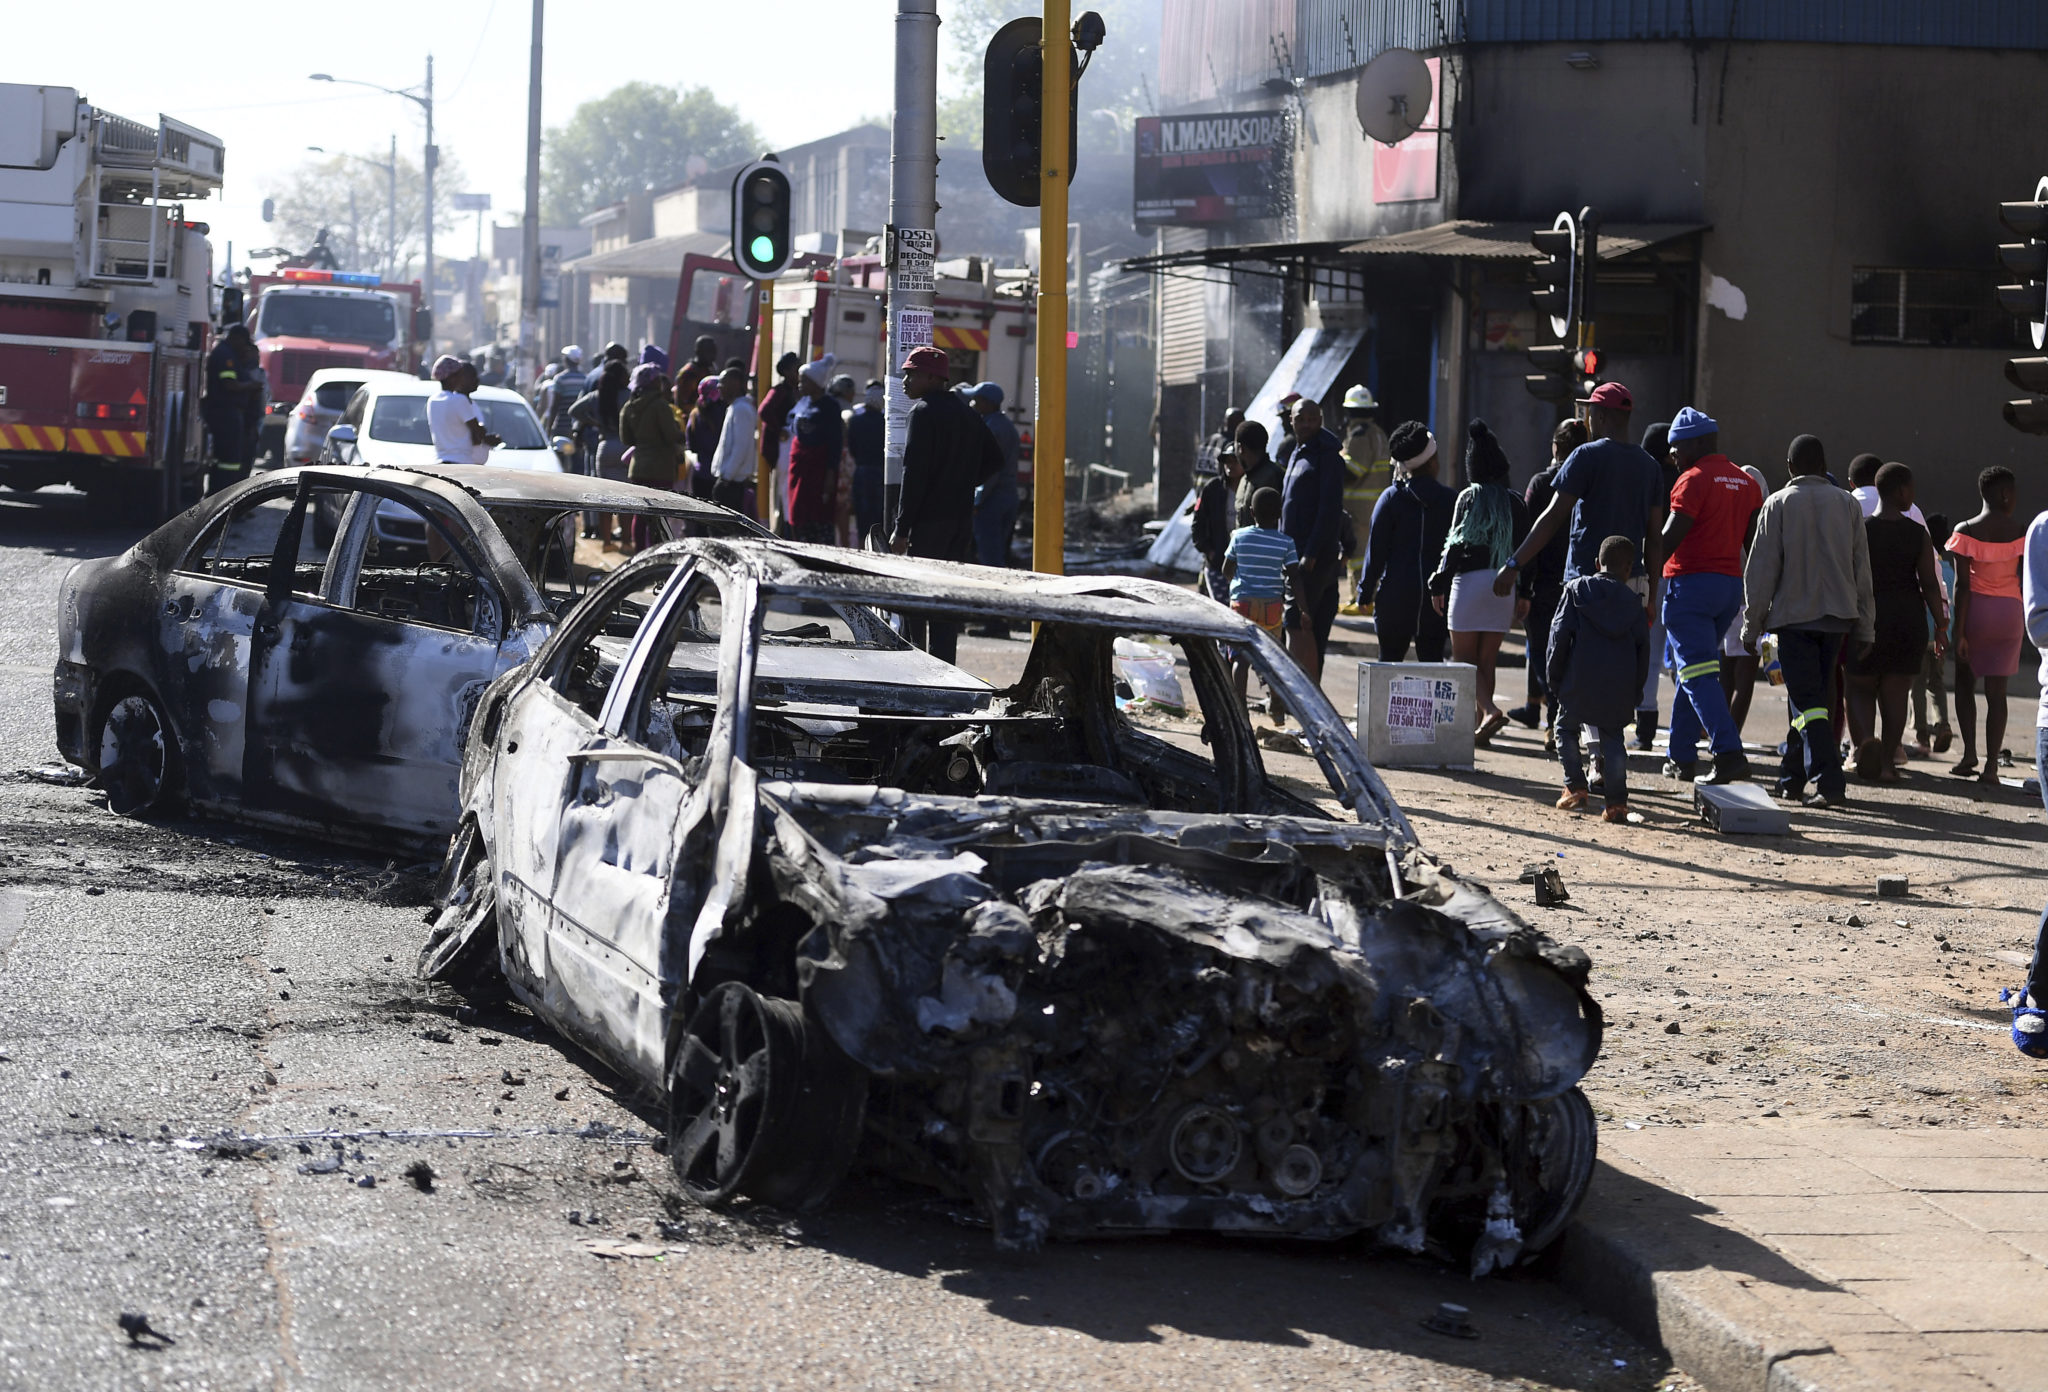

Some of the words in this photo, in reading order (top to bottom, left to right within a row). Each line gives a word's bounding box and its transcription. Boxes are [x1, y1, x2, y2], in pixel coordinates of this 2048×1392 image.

[901, 332, 912, 342] 078
[913, 332, 924, 343] 508
[1435, 680, 1452, 692] IS
[1391, 696, 1433, 709] ABORTION
[1388, 713, 1400, 725] 078
[1401, 715, 1414, 727] 508
[1415, 717, 1431, 729] 1333
